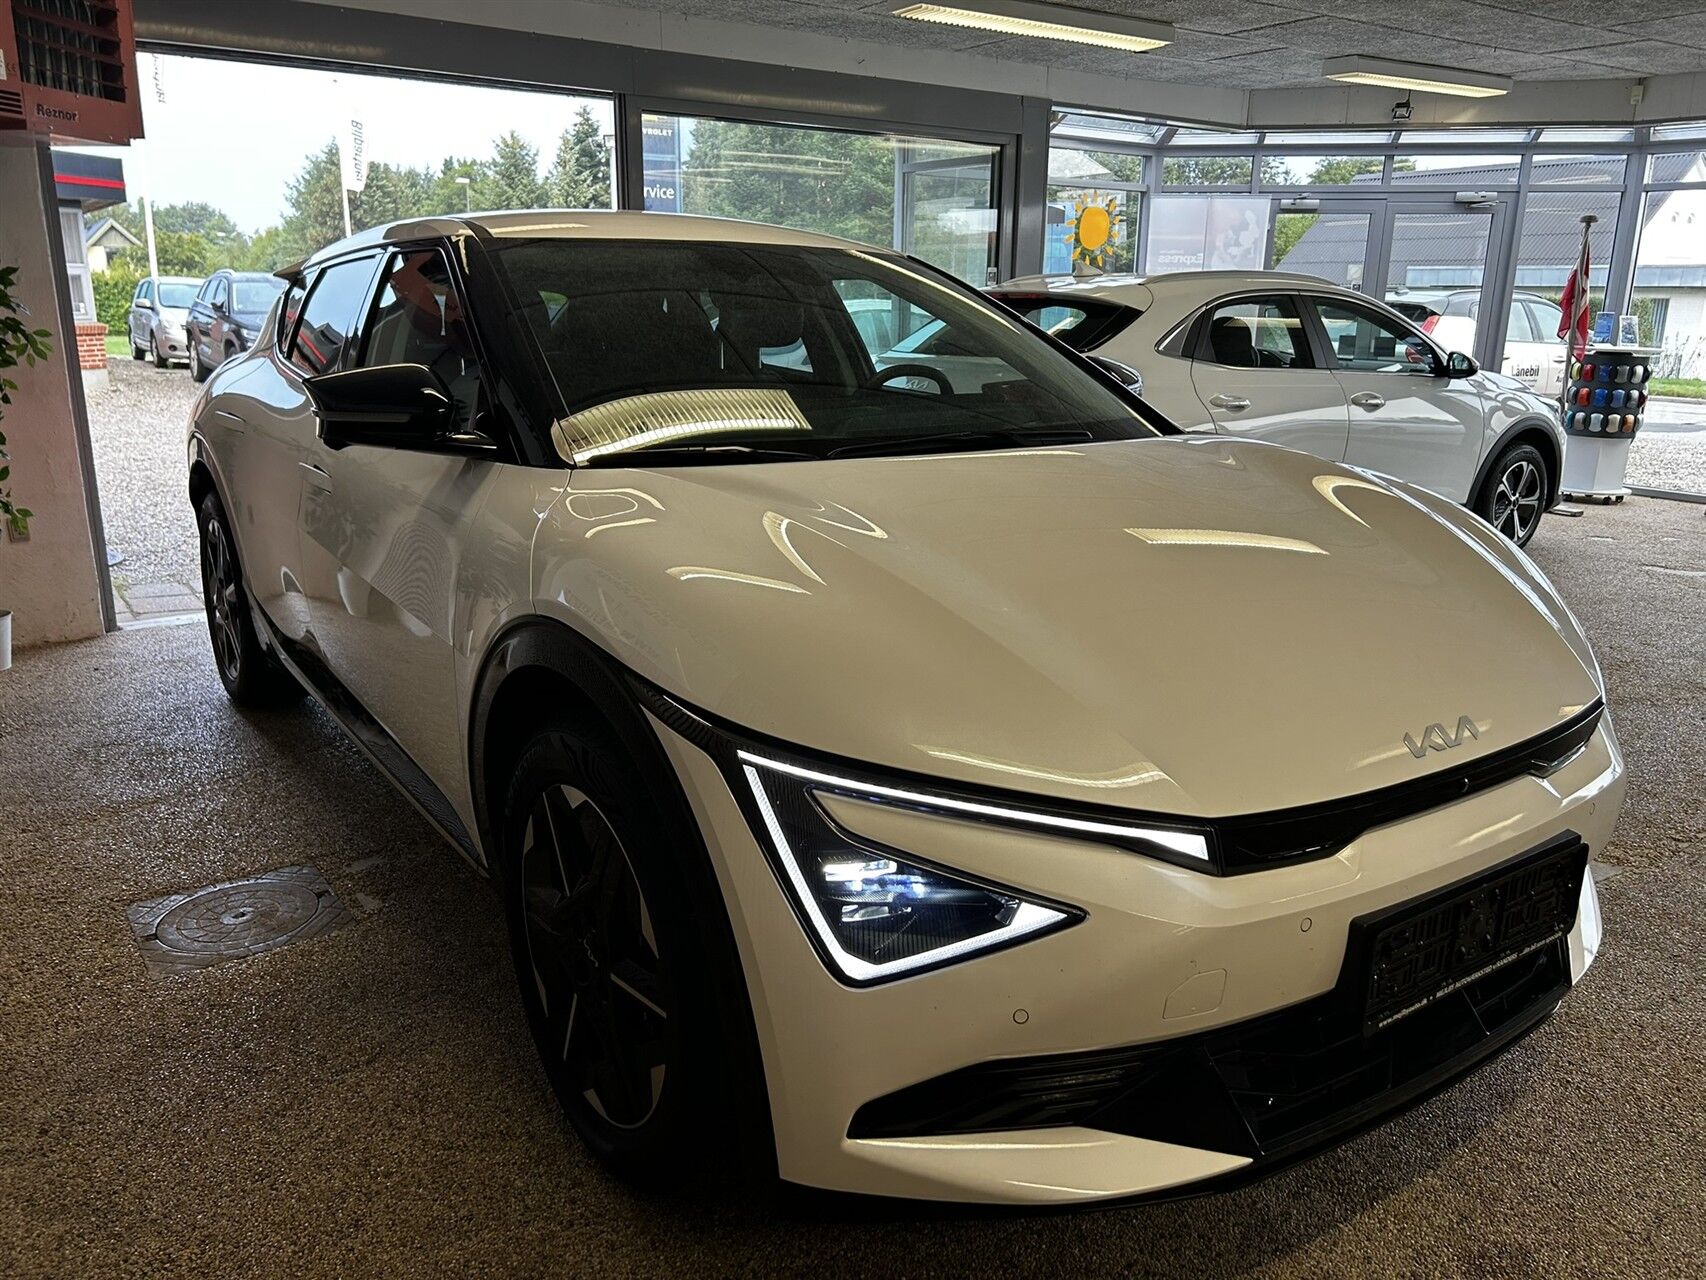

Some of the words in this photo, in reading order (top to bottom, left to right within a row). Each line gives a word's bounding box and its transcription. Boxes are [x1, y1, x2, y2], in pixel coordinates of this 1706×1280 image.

[36, 103, 79, 121] Reznor
[643, 184, 675, 199] rvice
[1511, 363, 1540, 377] Lånebil
[1403, 715, 1480, 759] KIA
